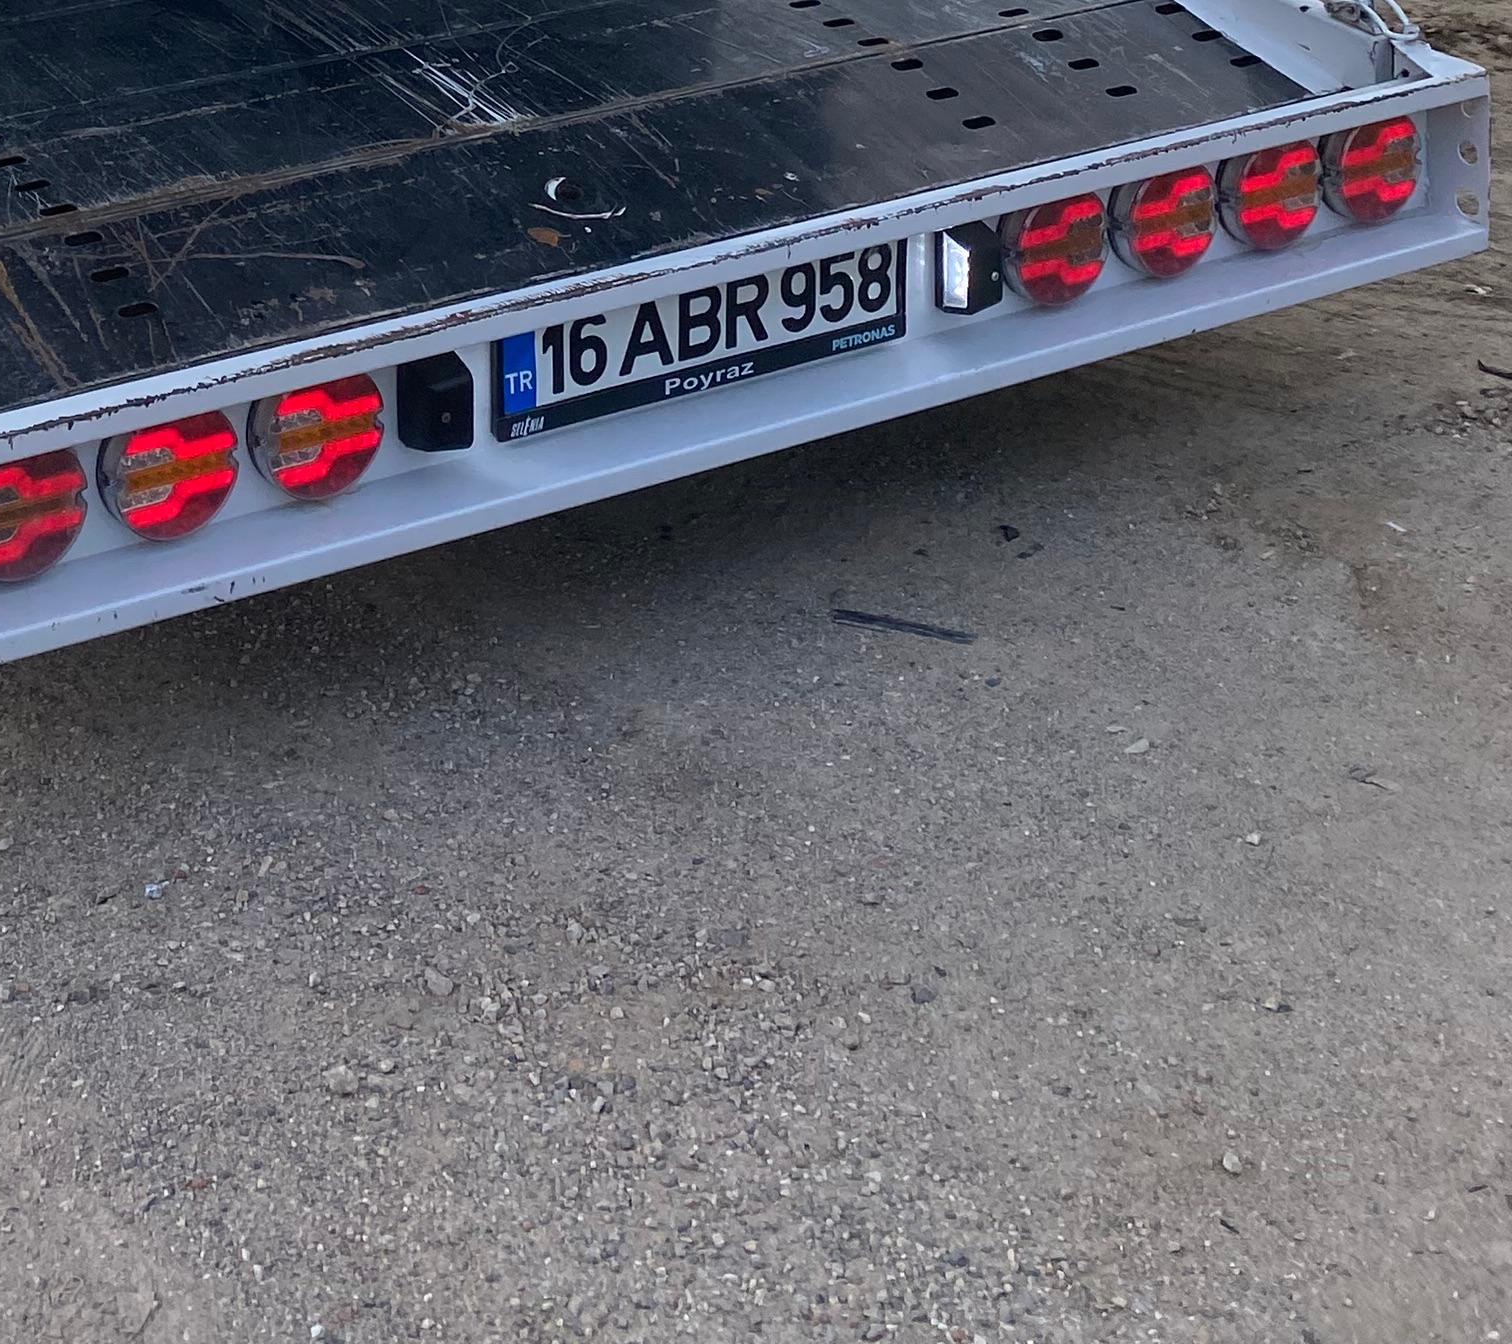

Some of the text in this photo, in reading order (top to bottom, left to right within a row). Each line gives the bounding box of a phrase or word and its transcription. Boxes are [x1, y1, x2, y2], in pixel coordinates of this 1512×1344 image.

[542, 245, 893, 394] 16 ABR 958
[505, 370, 533, 396] TR
[664, 361, 755, 396] Poyraz
[831, 323, 896, 353] PETRONAS
